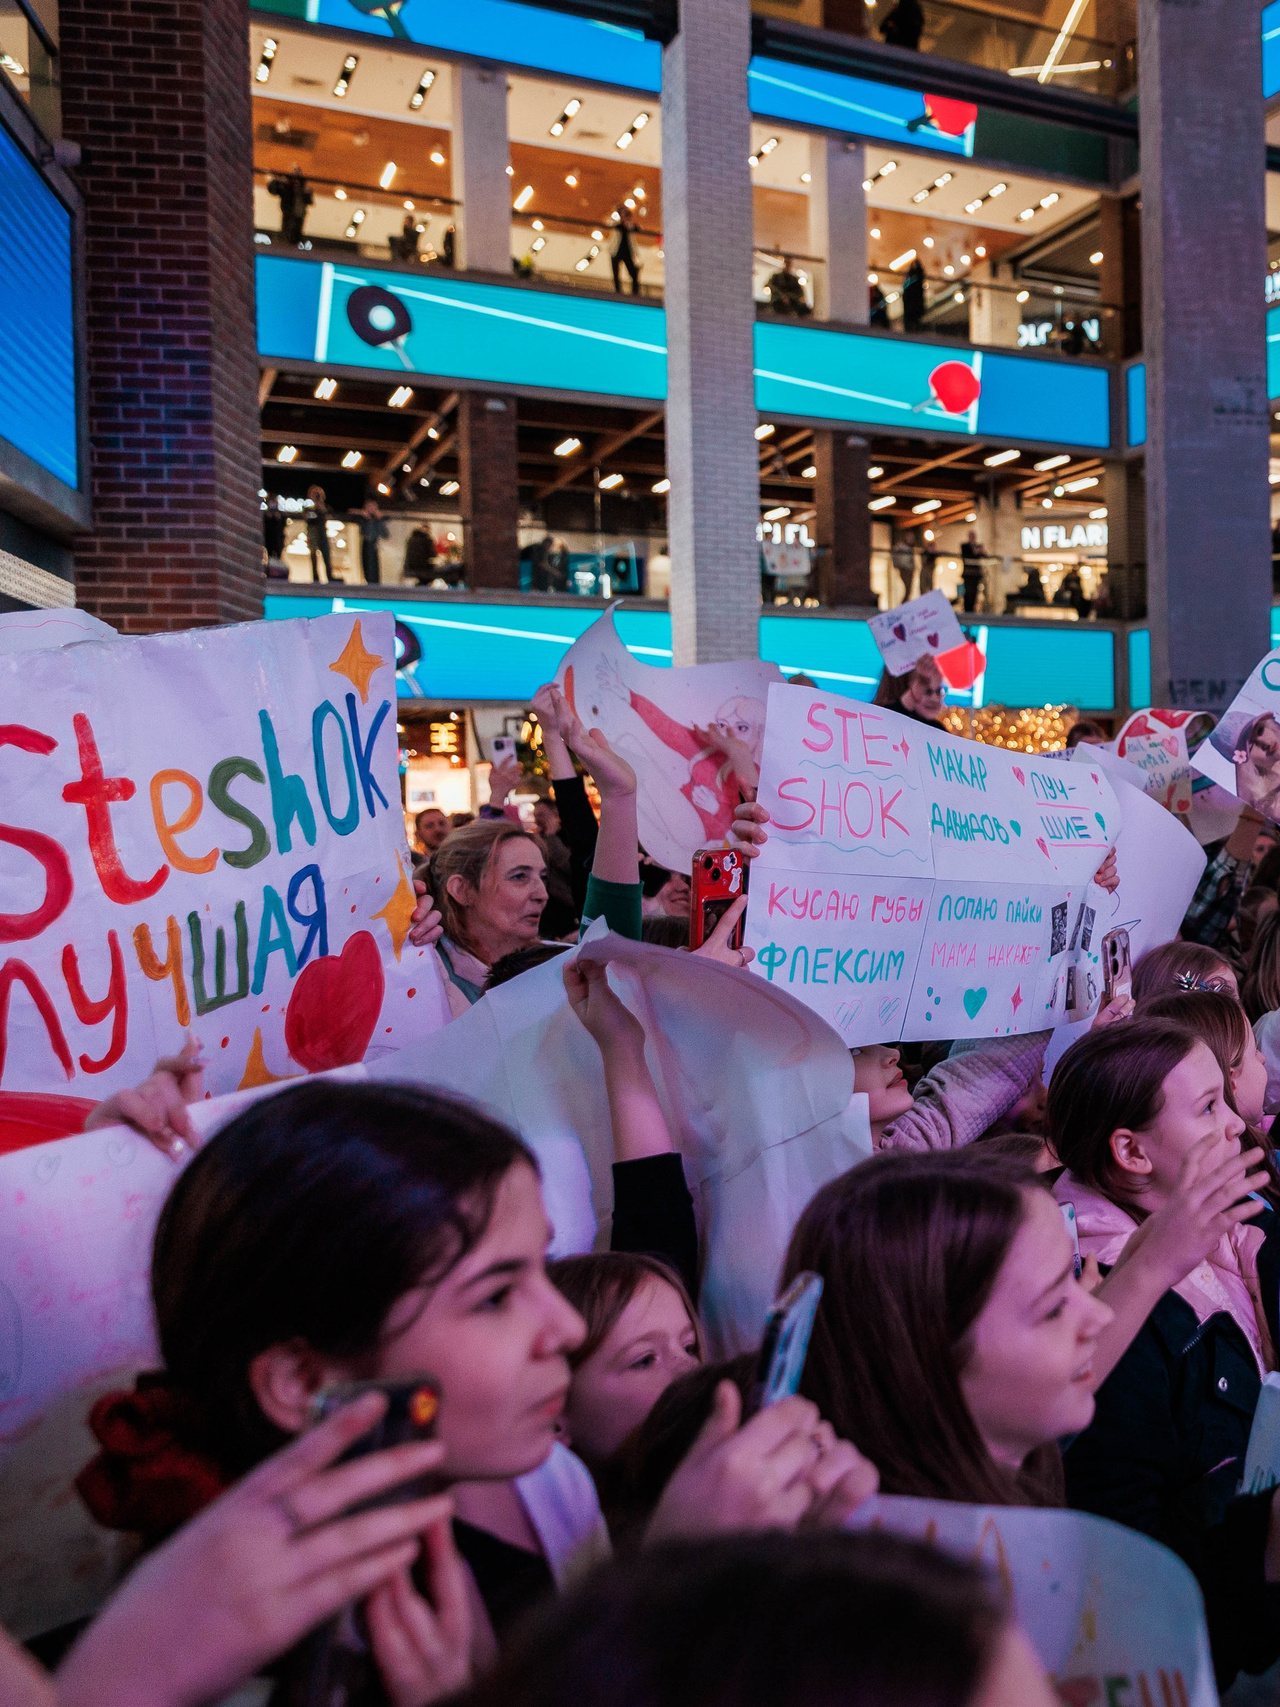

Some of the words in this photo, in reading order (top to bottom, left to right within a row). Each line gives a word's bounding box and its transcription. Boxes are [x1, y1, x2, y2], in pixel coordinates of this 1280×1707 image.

[927, 742, 988, 792] МАКАР
[769, 777, 911, 839] SHOK
[931, 802, 1009, 845] ДАВЫДОВ
[768, 882, 860, 922] КУСАЮ
[871, 894, 923, 923] ГУБЫ
[938, 894, 998, 922] ЛОПАЮ
[757, 941, 905, 985] ФЛЕКСИМ
[931, 942, 977, 969] МАМА
[987, 943, 1041, 969] НАКАЖЕТ
